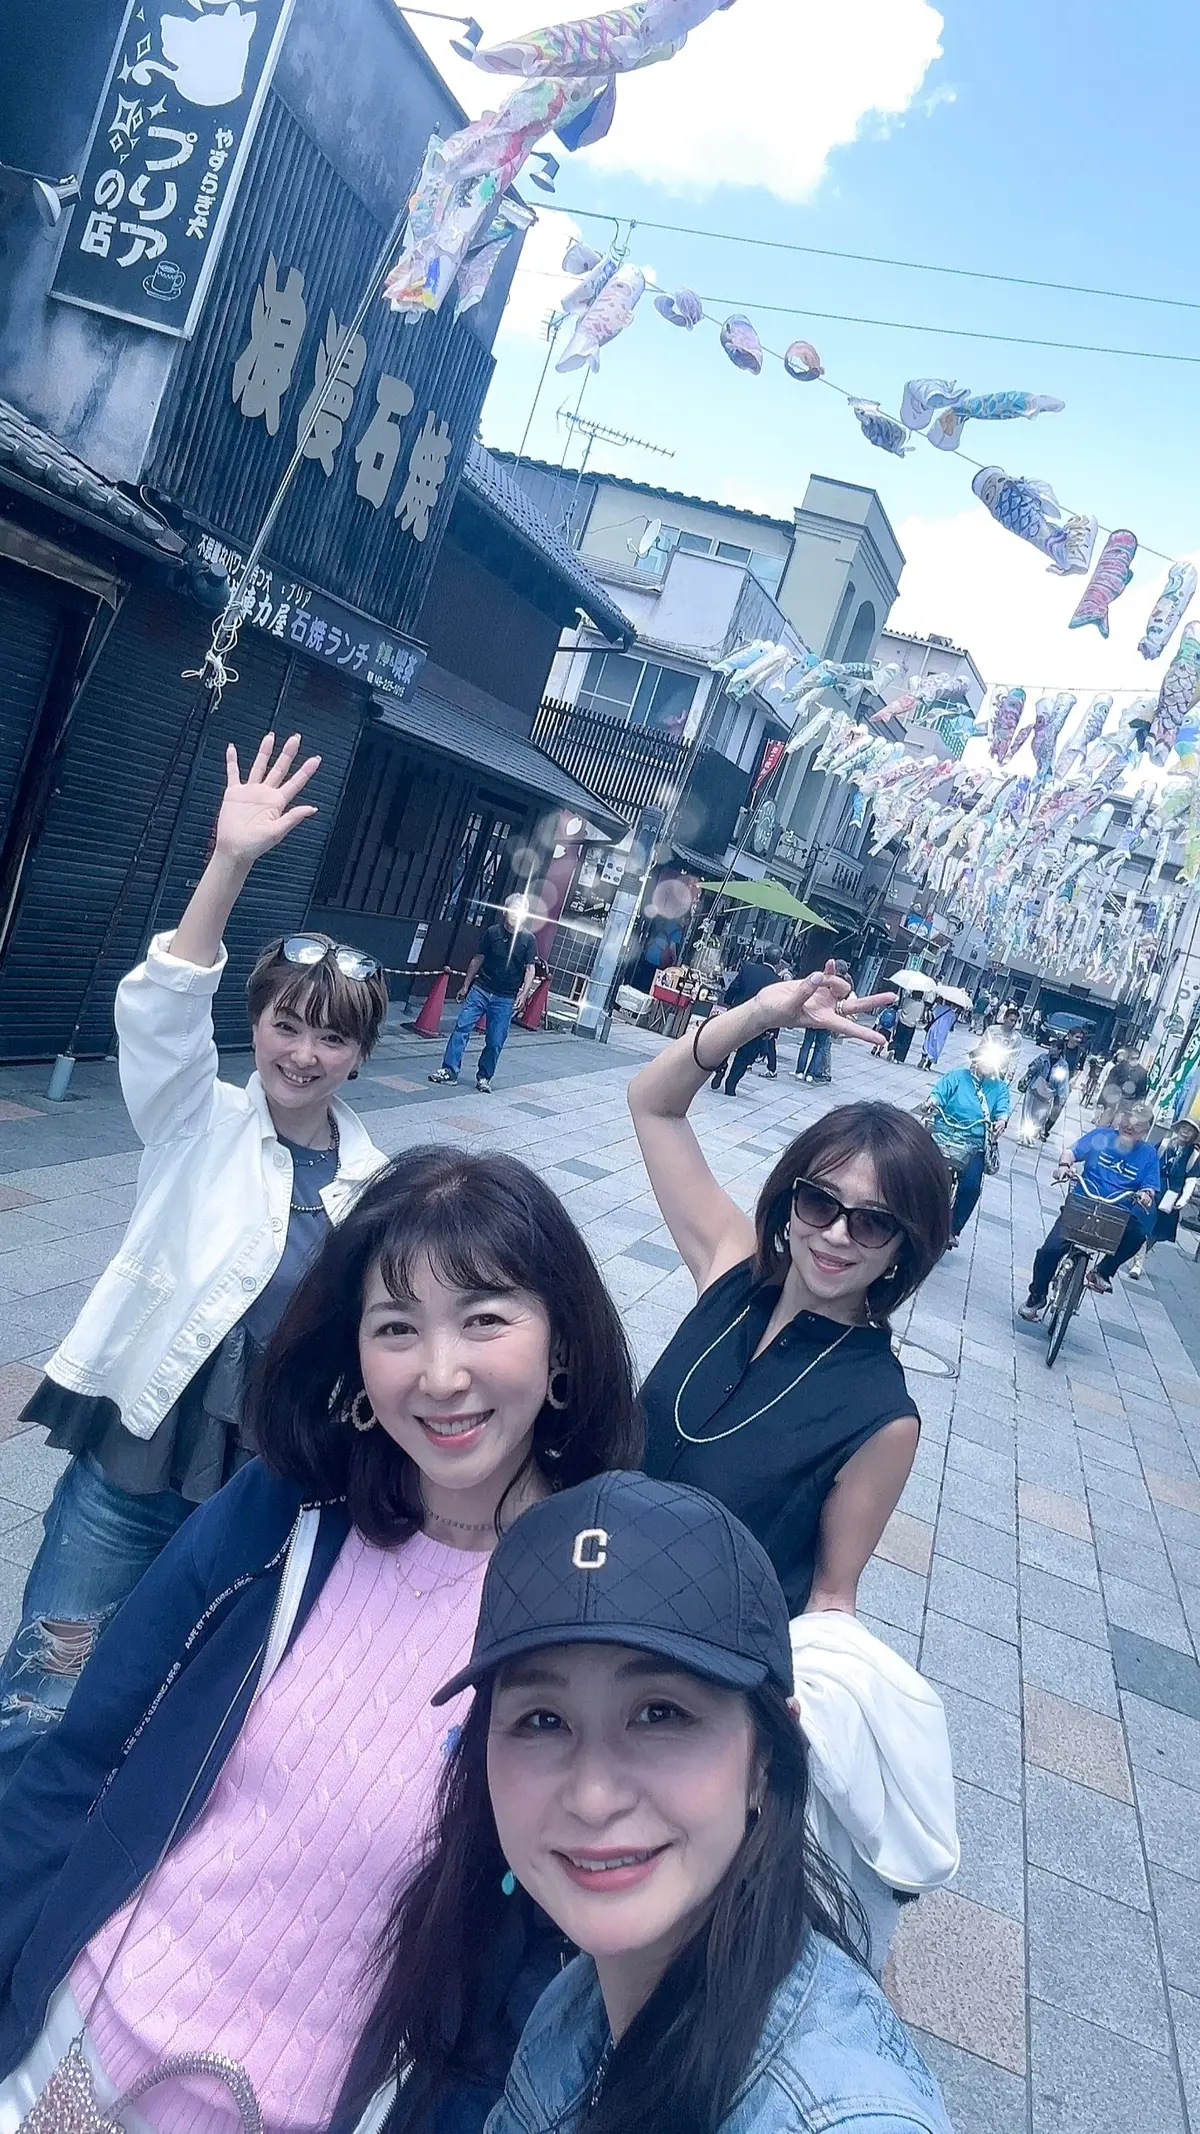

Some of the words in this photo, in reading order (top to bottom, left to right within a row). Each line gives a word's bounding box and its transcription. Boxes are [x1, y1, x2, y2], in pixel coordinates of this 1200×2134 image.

[79, 168, 126, 258] の店
[115, 125, 199, 268] プリア
[290, 607, 371, 671] 石焼ランチ
[571, 1527, 609, 1570] C
